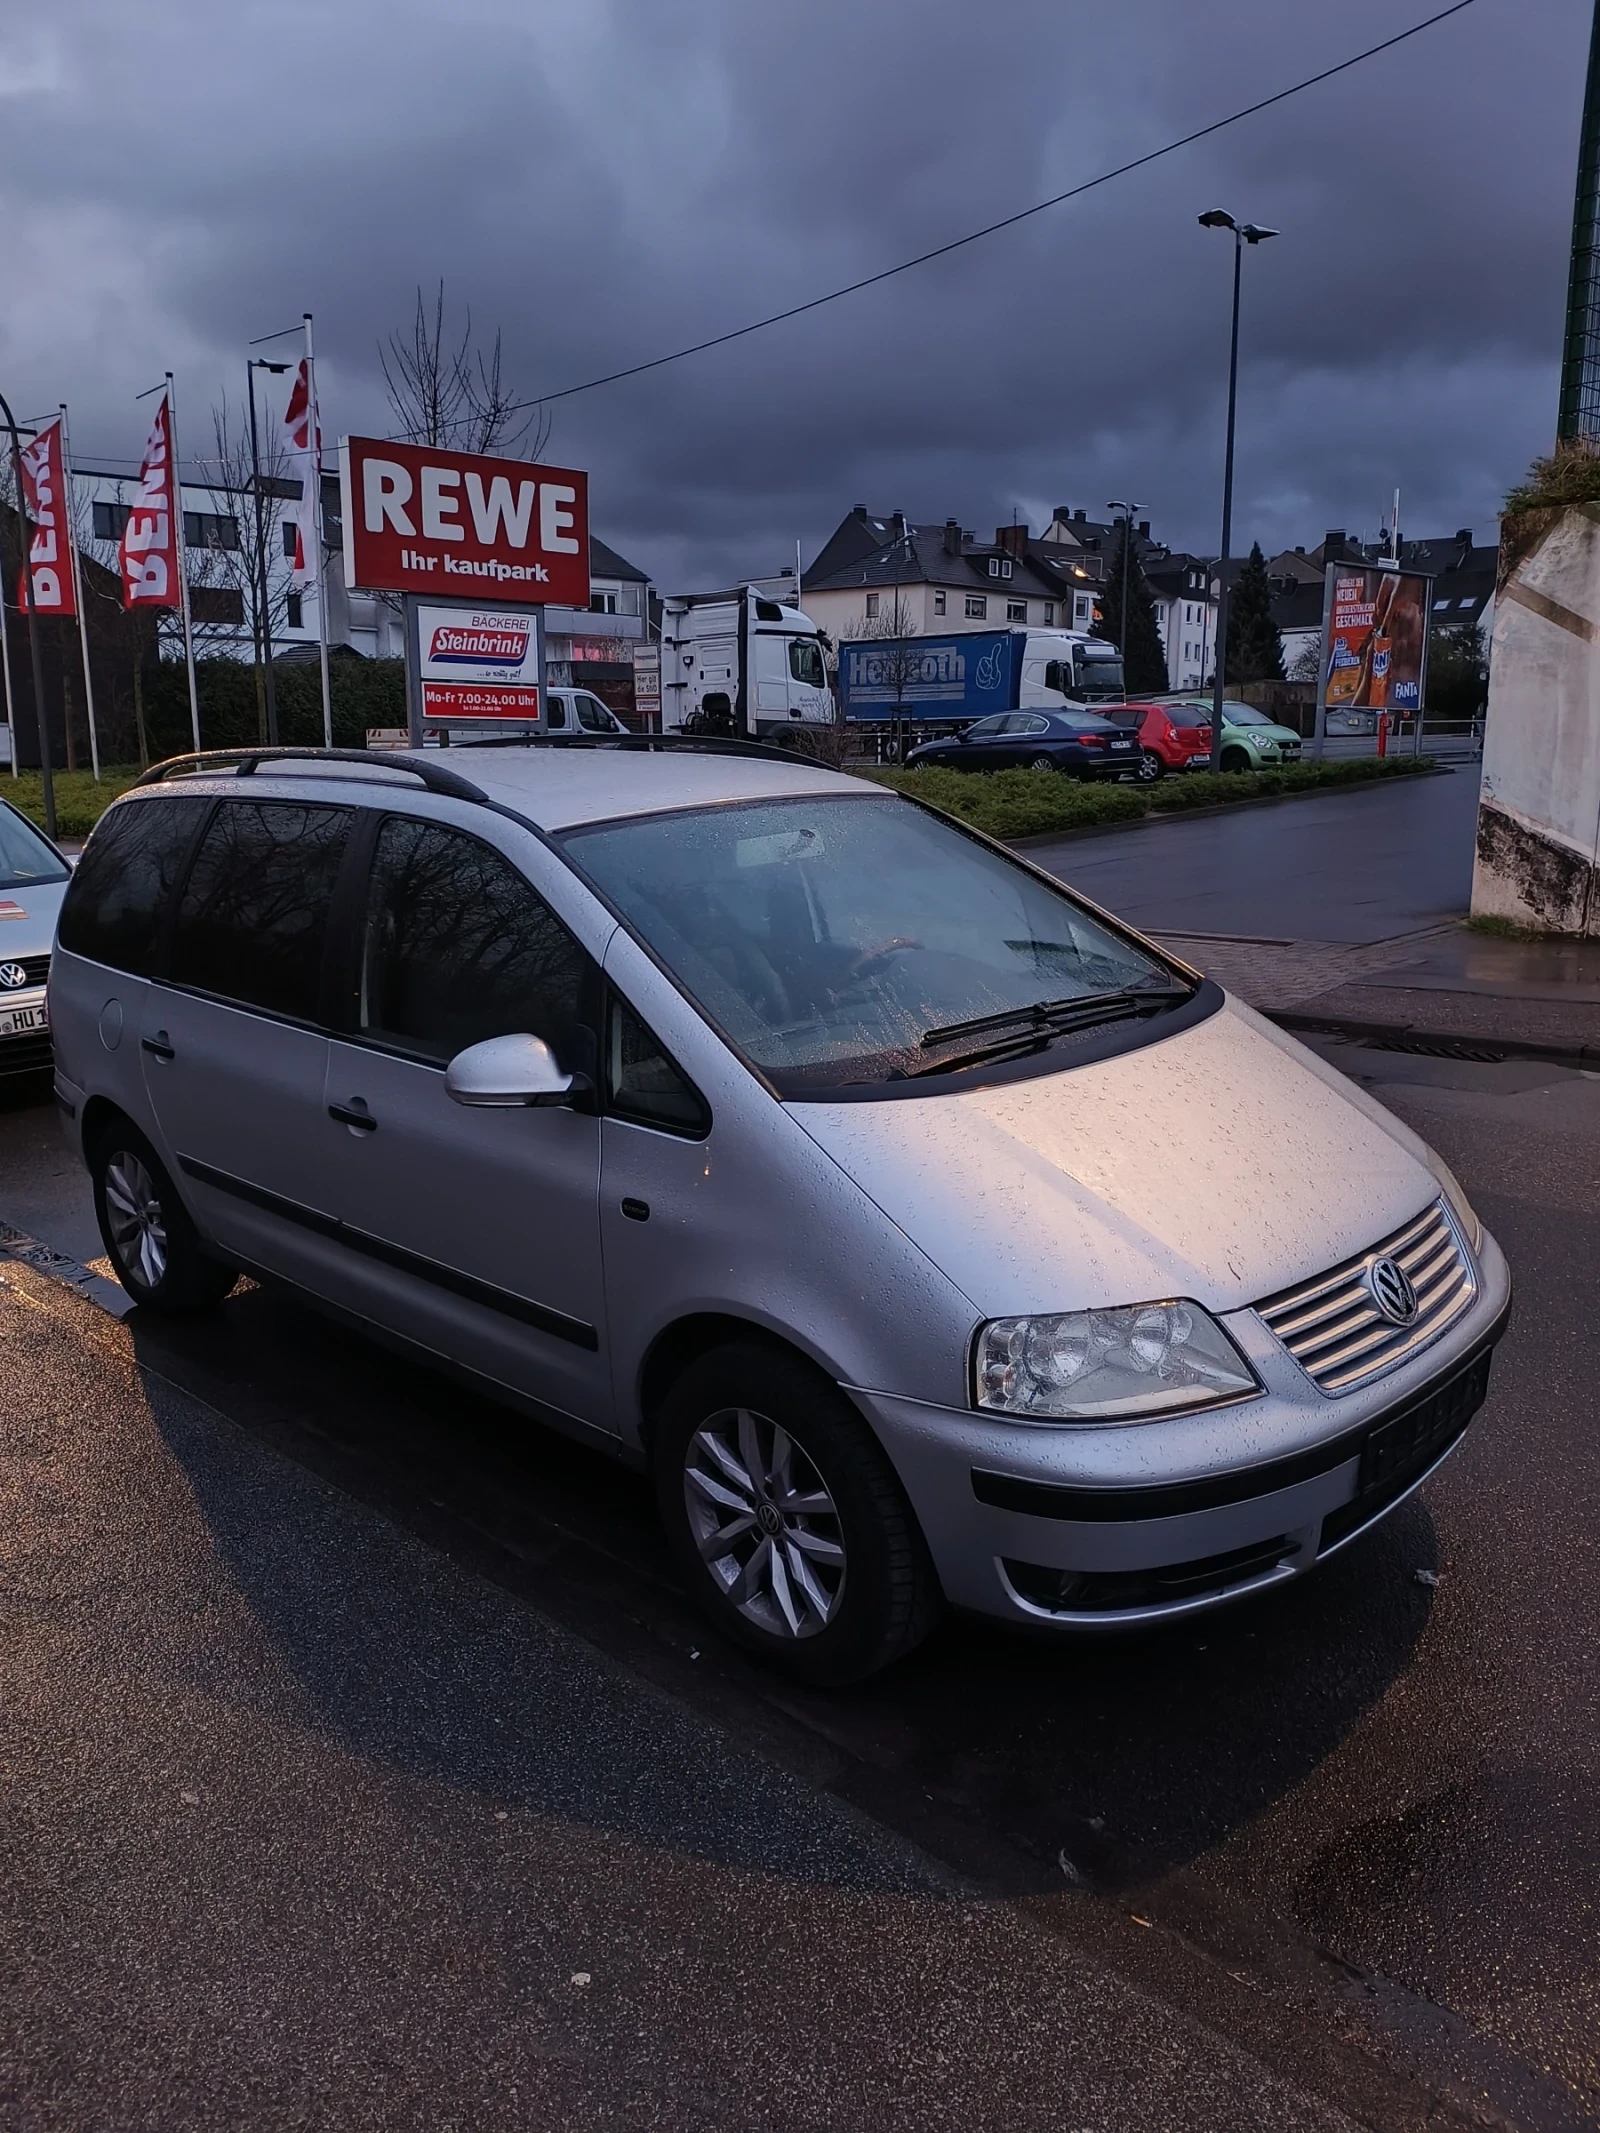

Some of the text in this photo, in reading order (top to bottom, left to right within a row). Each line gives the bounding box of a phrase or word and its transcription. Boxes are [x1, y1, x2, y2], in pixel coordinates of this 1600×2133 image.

[362, 457, 579, 554] REWE
[401, 549, 550, 582] Ihr kaufpark
[1336, 588, 1357, 602] NEUEN
[471, 613, 530, 630] BÄCKEREI
[1335, 612, 1374, 628] GESCHMACK
[436, 628, 523, 654] Steinbrink
[426, 691, 535, 706] Mo-Fr 7.00-24.00 Uhr
[1395, 682, 1418, 699] FANTA
[12, 1010, 35, 1030] HU
